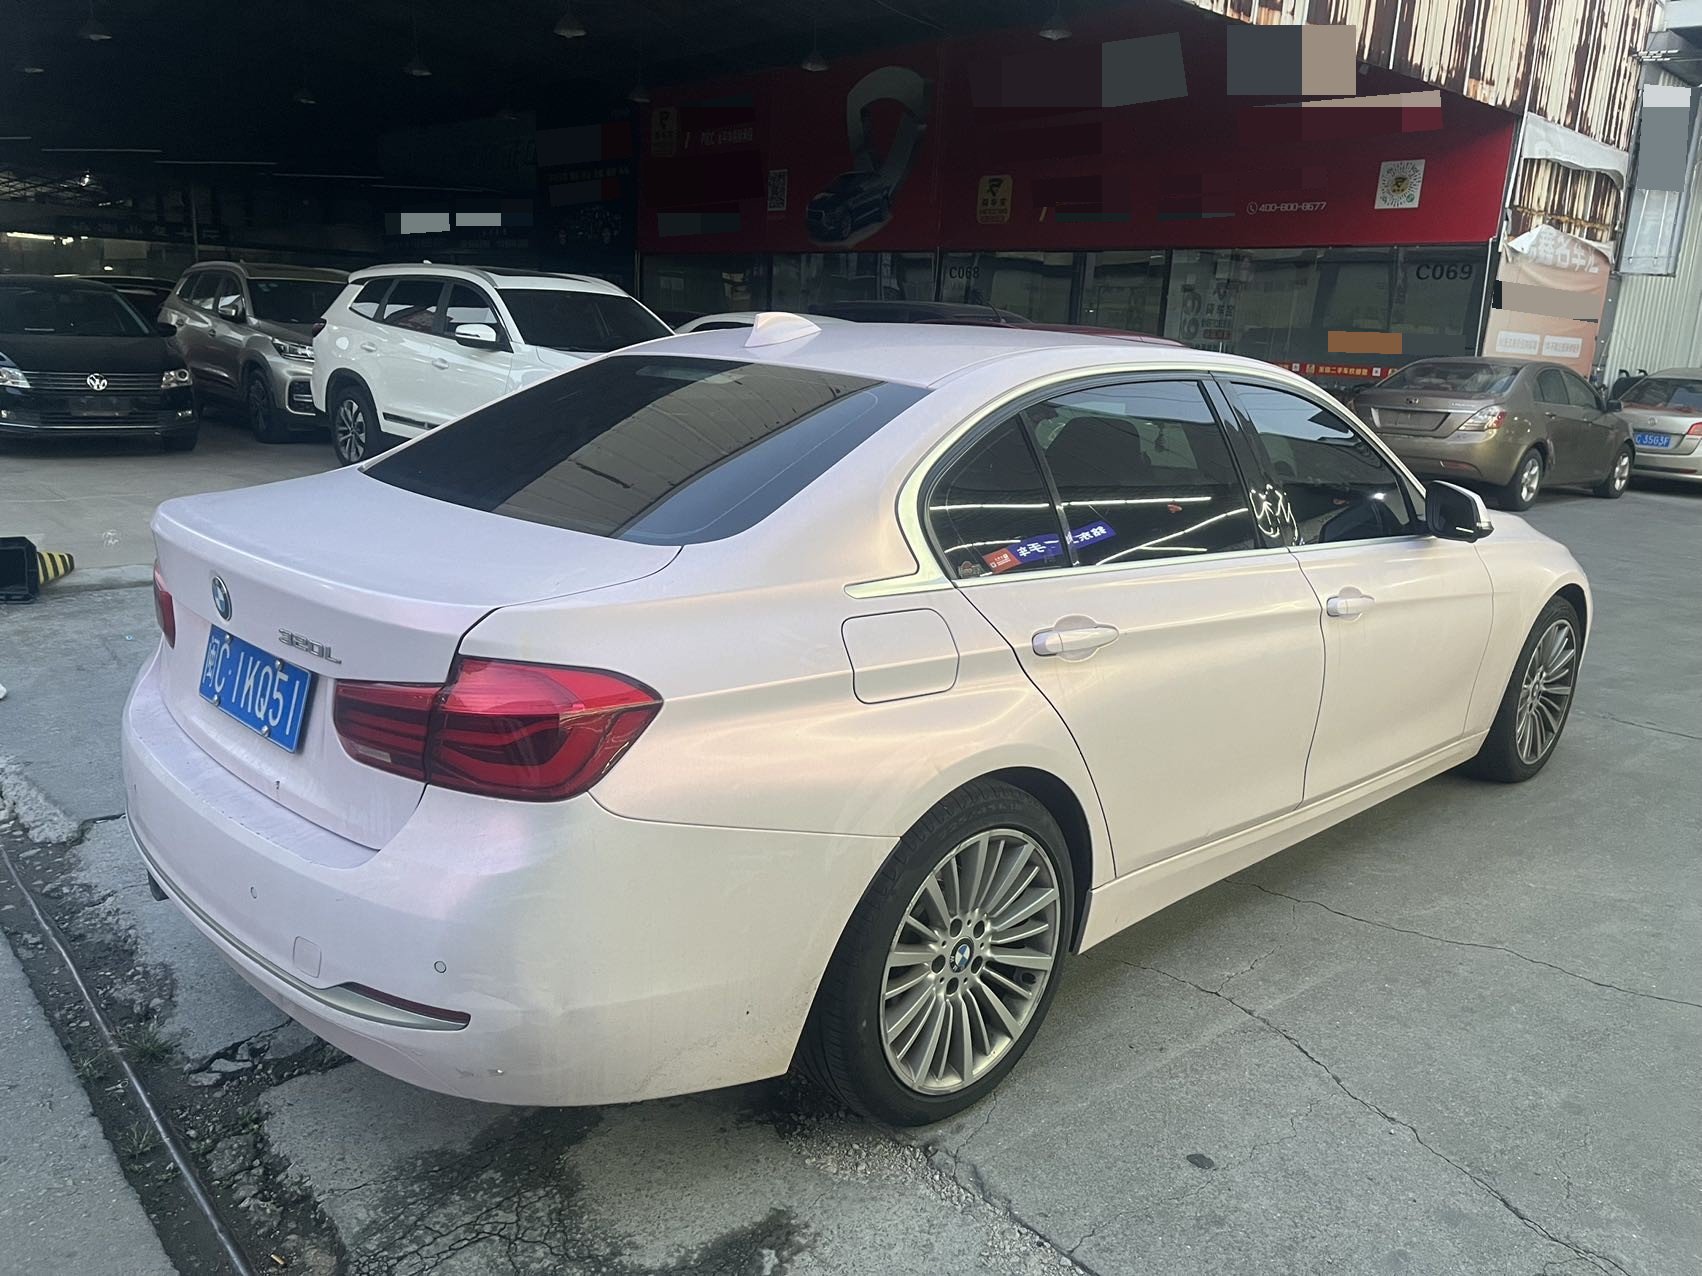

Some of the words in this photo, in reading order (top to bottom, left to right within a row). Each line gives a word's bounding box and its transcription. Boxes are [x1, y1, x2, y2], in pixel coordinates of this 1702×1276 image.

[949, 266, 980, 279] C068
[1415, 263, 1473, 280] C069
[278, 627, 343, 665] 320L
